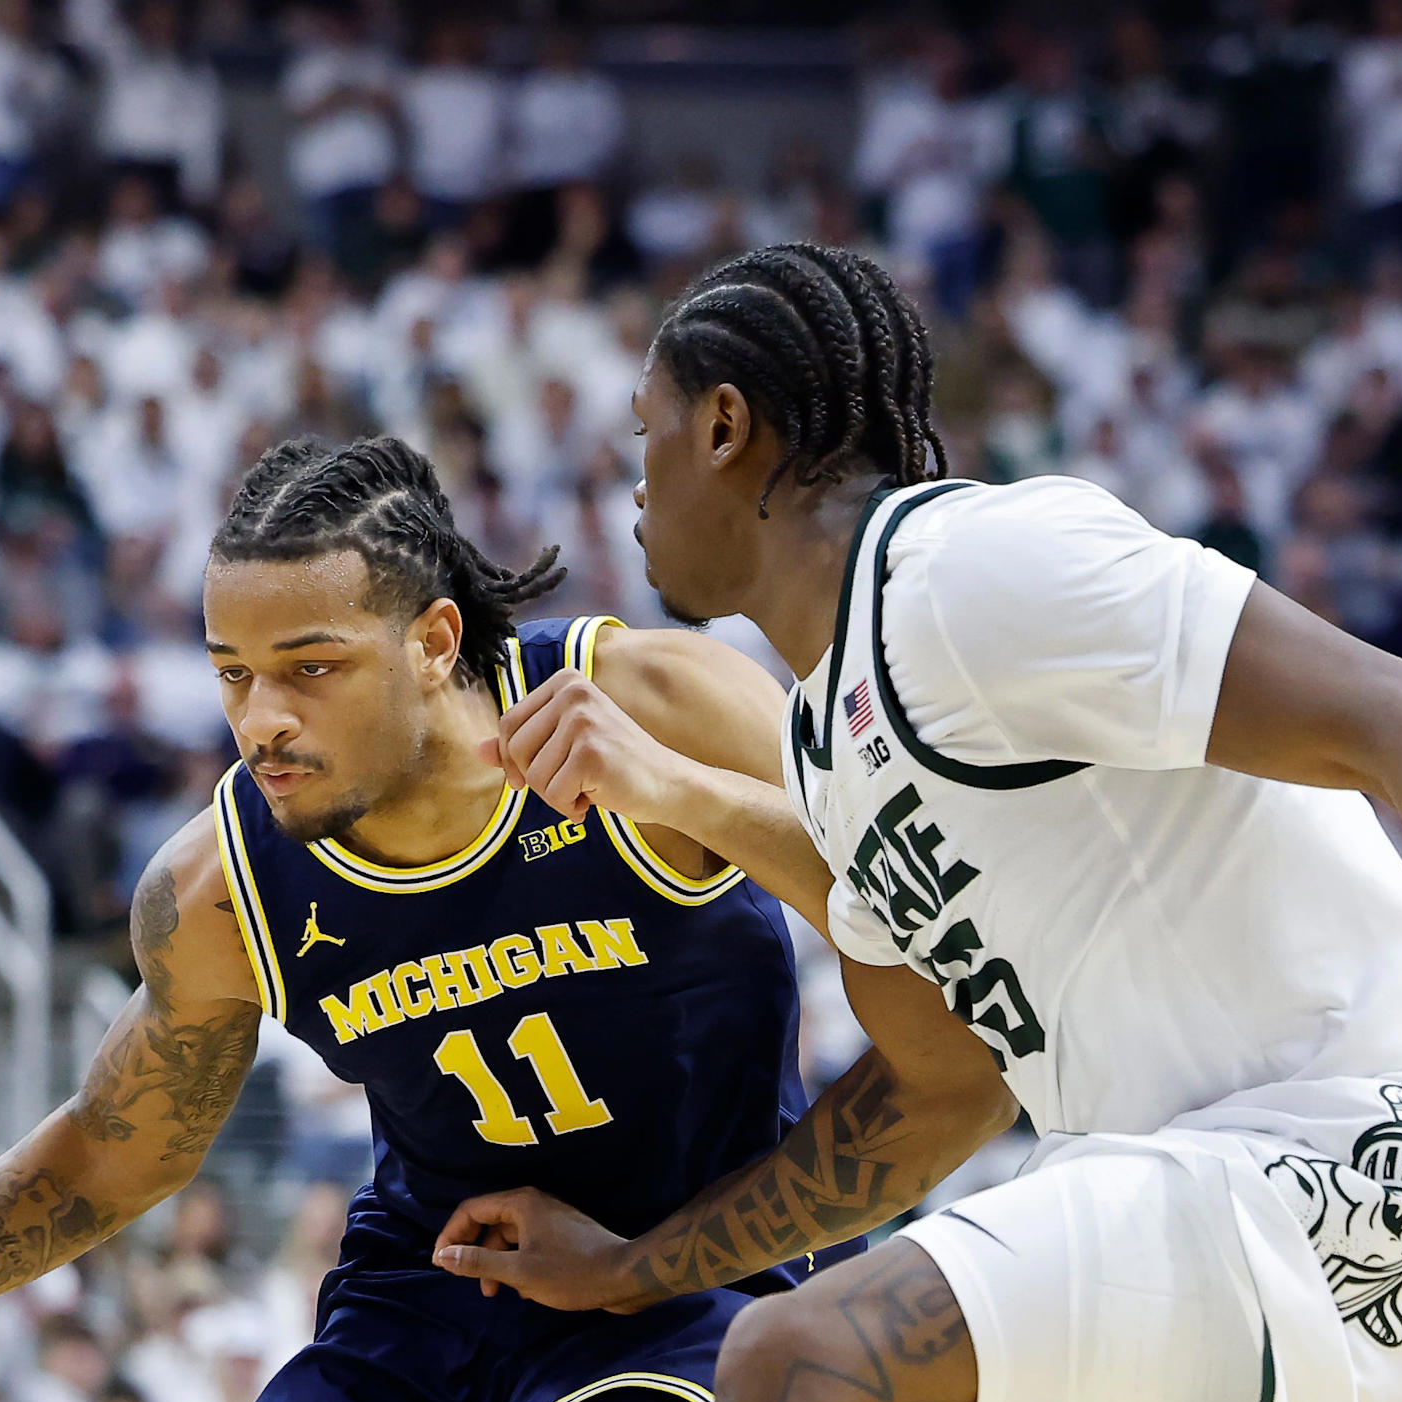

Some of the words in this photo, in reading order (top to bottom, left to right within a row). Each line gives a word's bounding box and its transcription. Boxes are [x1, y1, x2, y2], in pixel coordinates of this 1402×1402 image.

[318, 917, 649, 1045] MICHIGAN
[920, 917, 1046, 1073] 5
[432, 1011, 614, 1146] 11
